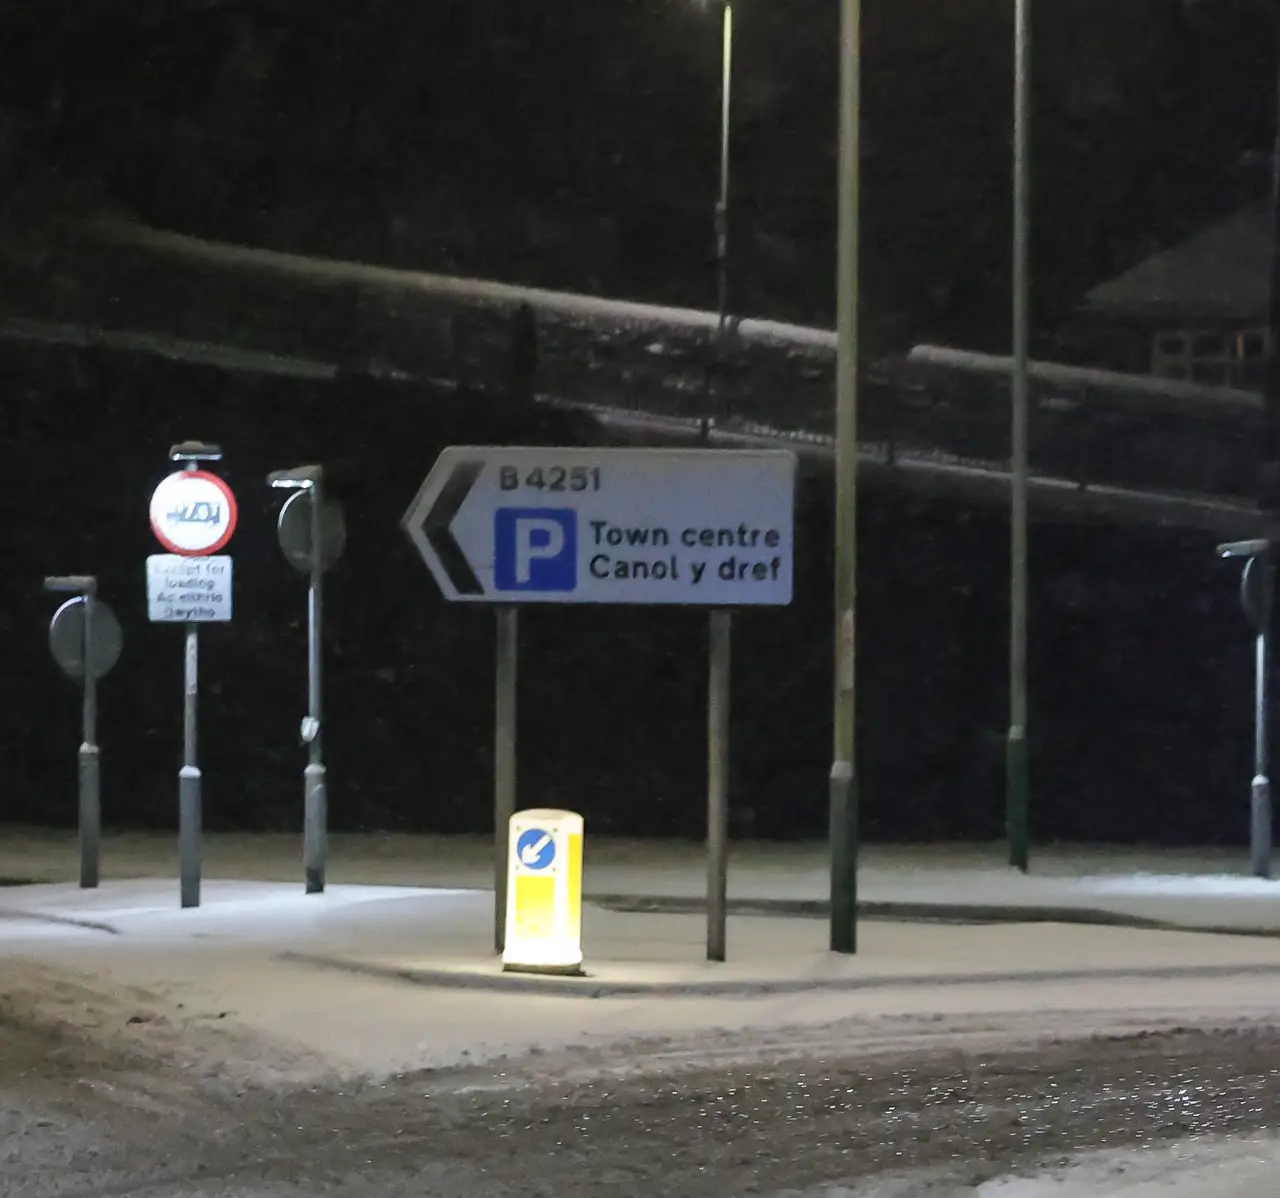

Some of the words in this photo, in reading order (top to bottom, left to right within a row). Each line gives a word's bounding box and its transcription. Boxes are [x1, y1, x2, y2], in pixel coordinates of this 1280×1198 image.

[500, 466, 518, 491] B
[526, 466, 601, 491] 4251
[590, 521, 669, 547] Town
[681, 523, 780, 548] centre
[515, 517, 564, 584] P
[590, 554, 678, 580] Canol
[691, 561, 706, 584] y
[718, 556, 781, 581] dref
